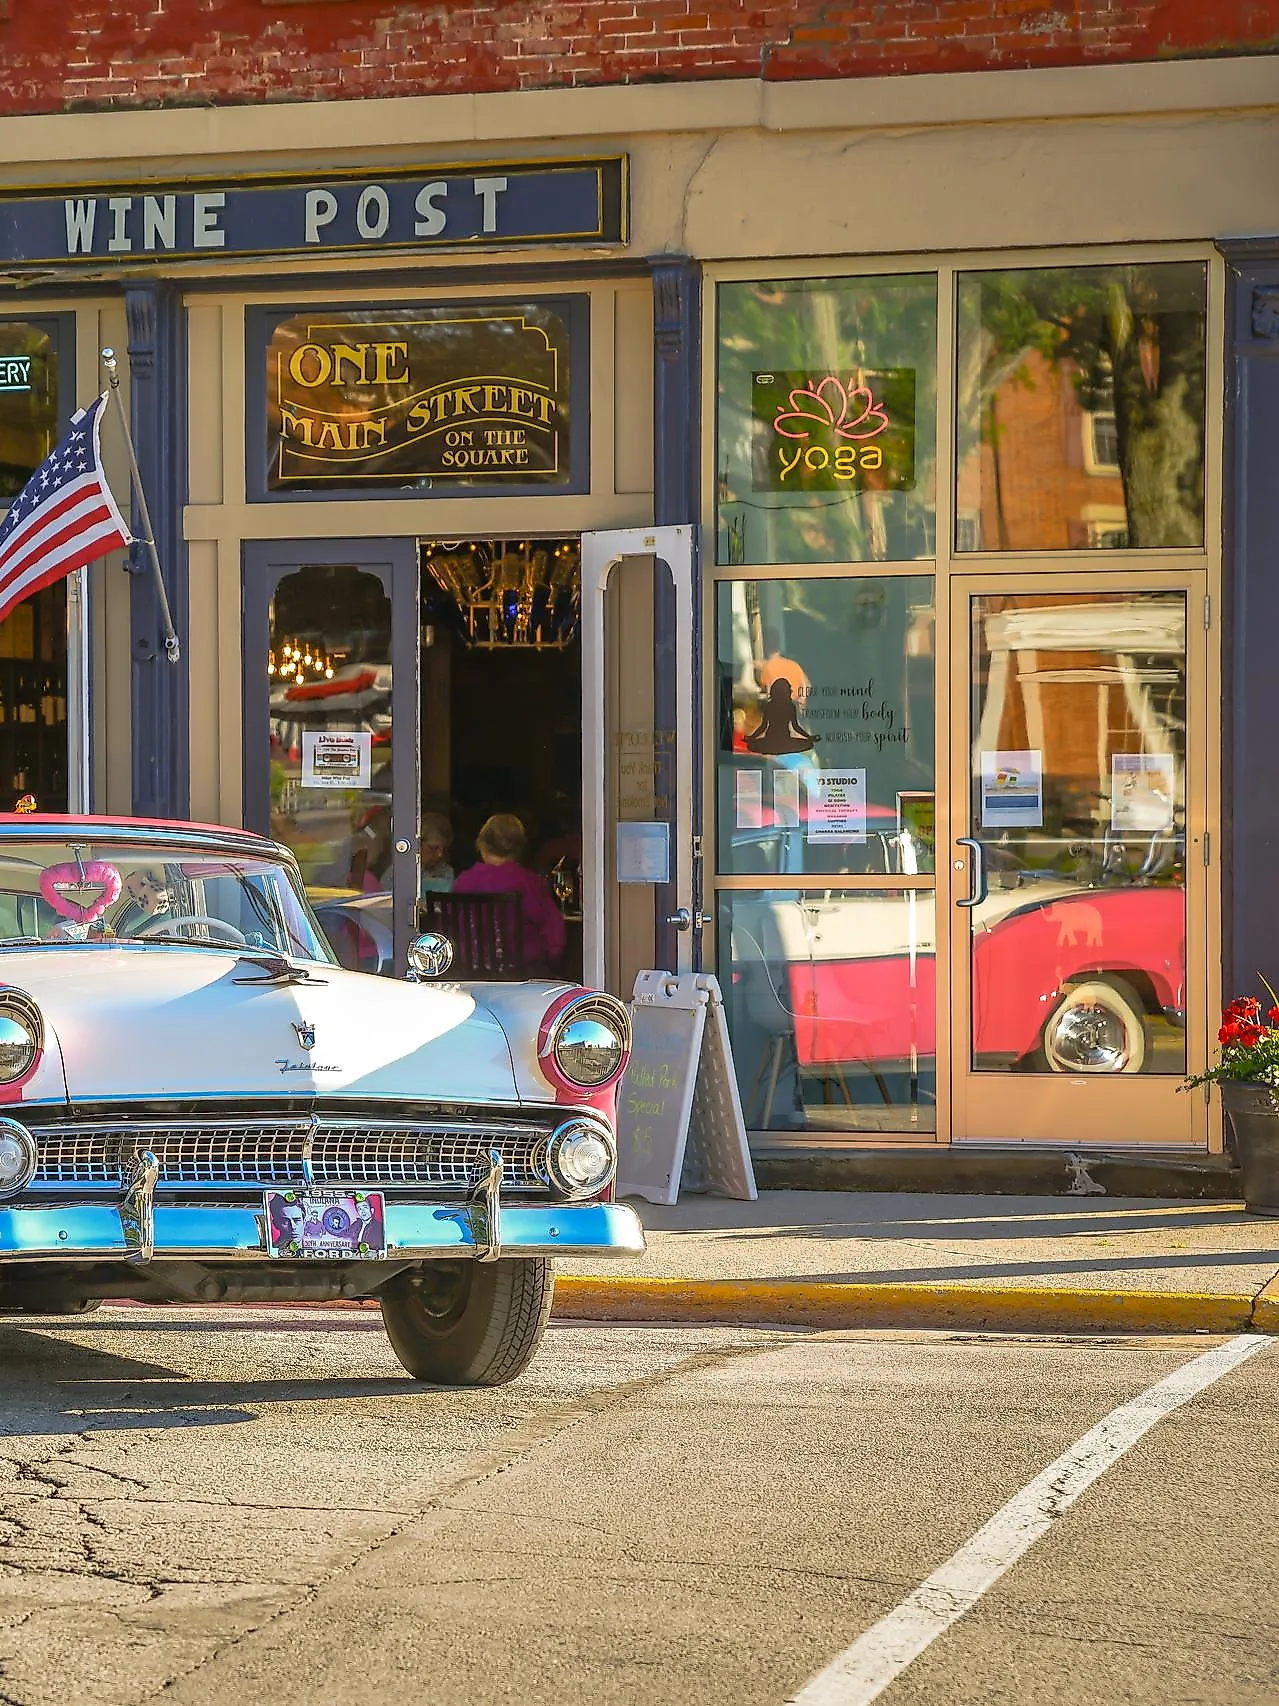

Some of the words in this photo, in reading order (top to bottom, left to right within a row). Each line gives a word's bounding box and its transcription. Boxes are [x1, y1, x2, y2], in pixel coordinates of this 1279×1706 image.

[65, 193, 225, 254] WINE
[305, 177, 508, 243] POST
[289, 341, 410, 388] ONE
[279, 407, 389, 451] MAIN
[406, 385, 556, 432] STREET
[445, 430, 473, 447] ON
[483, 430, 526, 446] THE
[441, 449, 529, 468] SQUARE
[778, 445, 882, 481] yoga
[840, 678, 874, 698] mind
[862, 701, 895, 729] body
[873, 728, 911, 752] spirit
[304, 1249, 353, 1259] FORD
